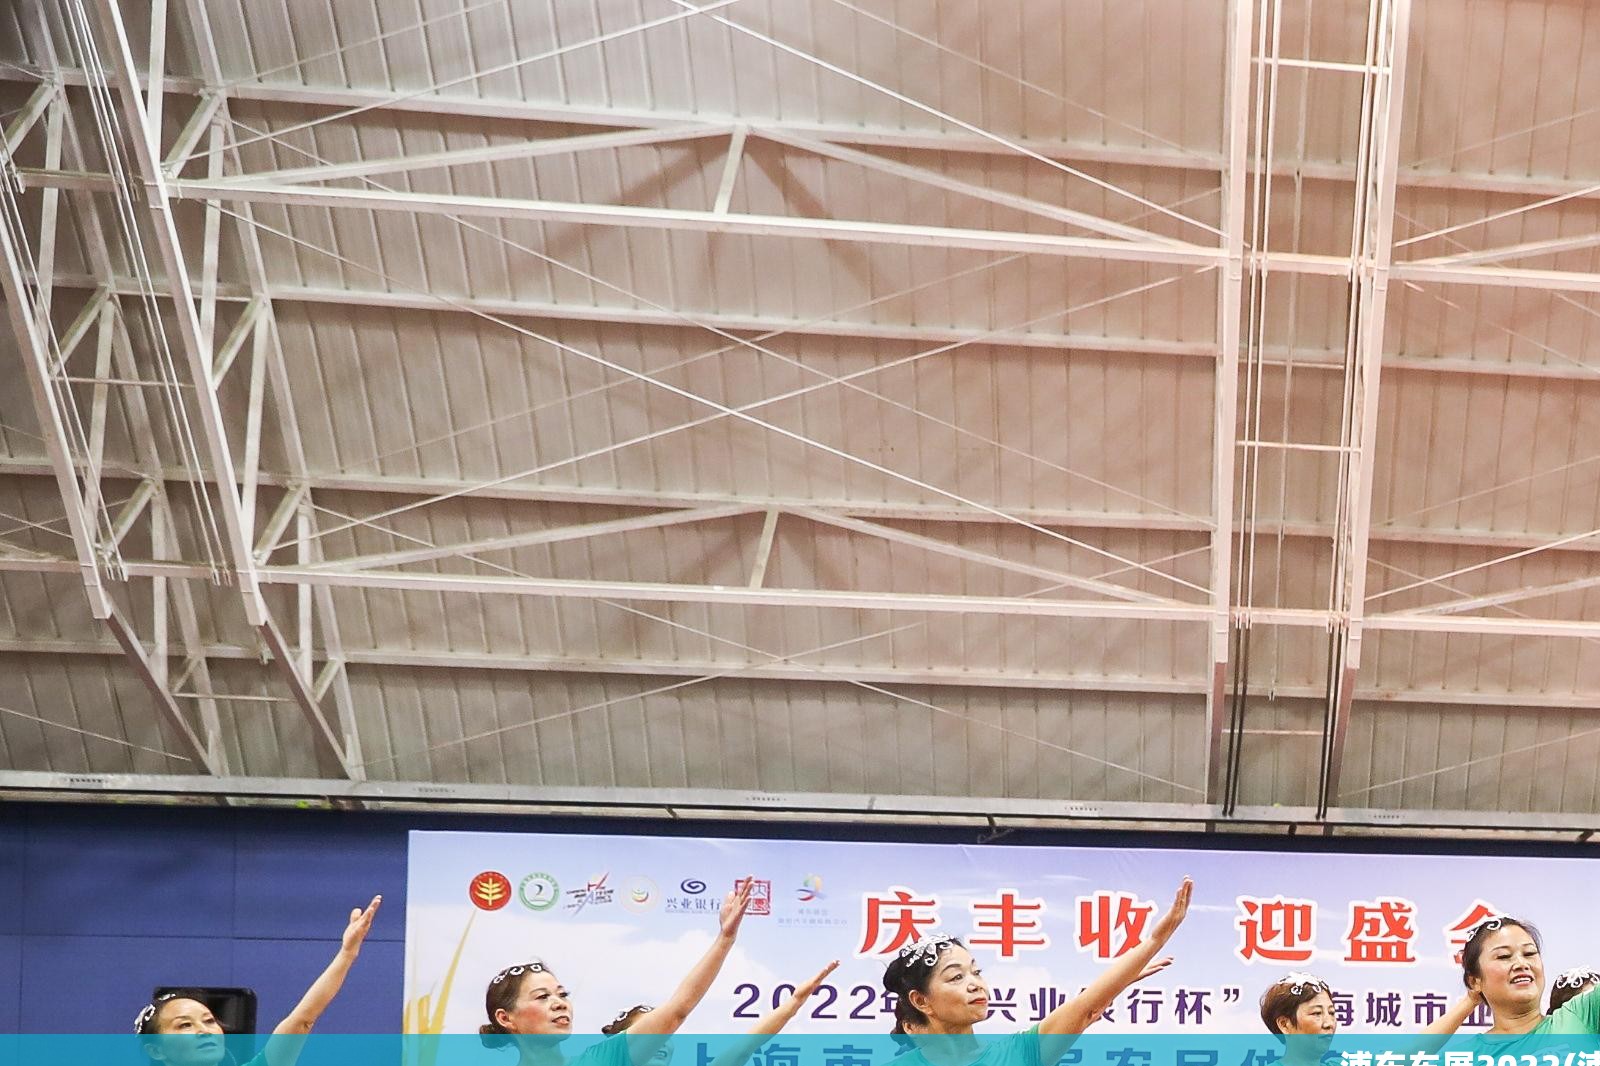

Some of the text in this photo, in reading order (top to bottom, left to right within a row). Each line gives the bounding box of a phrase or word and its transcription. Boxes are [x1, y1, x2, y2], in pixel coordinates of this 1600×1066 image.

[666, 898, 721, 909] 兴业银行
[858, 890, 1153, 958] 庆丰收
